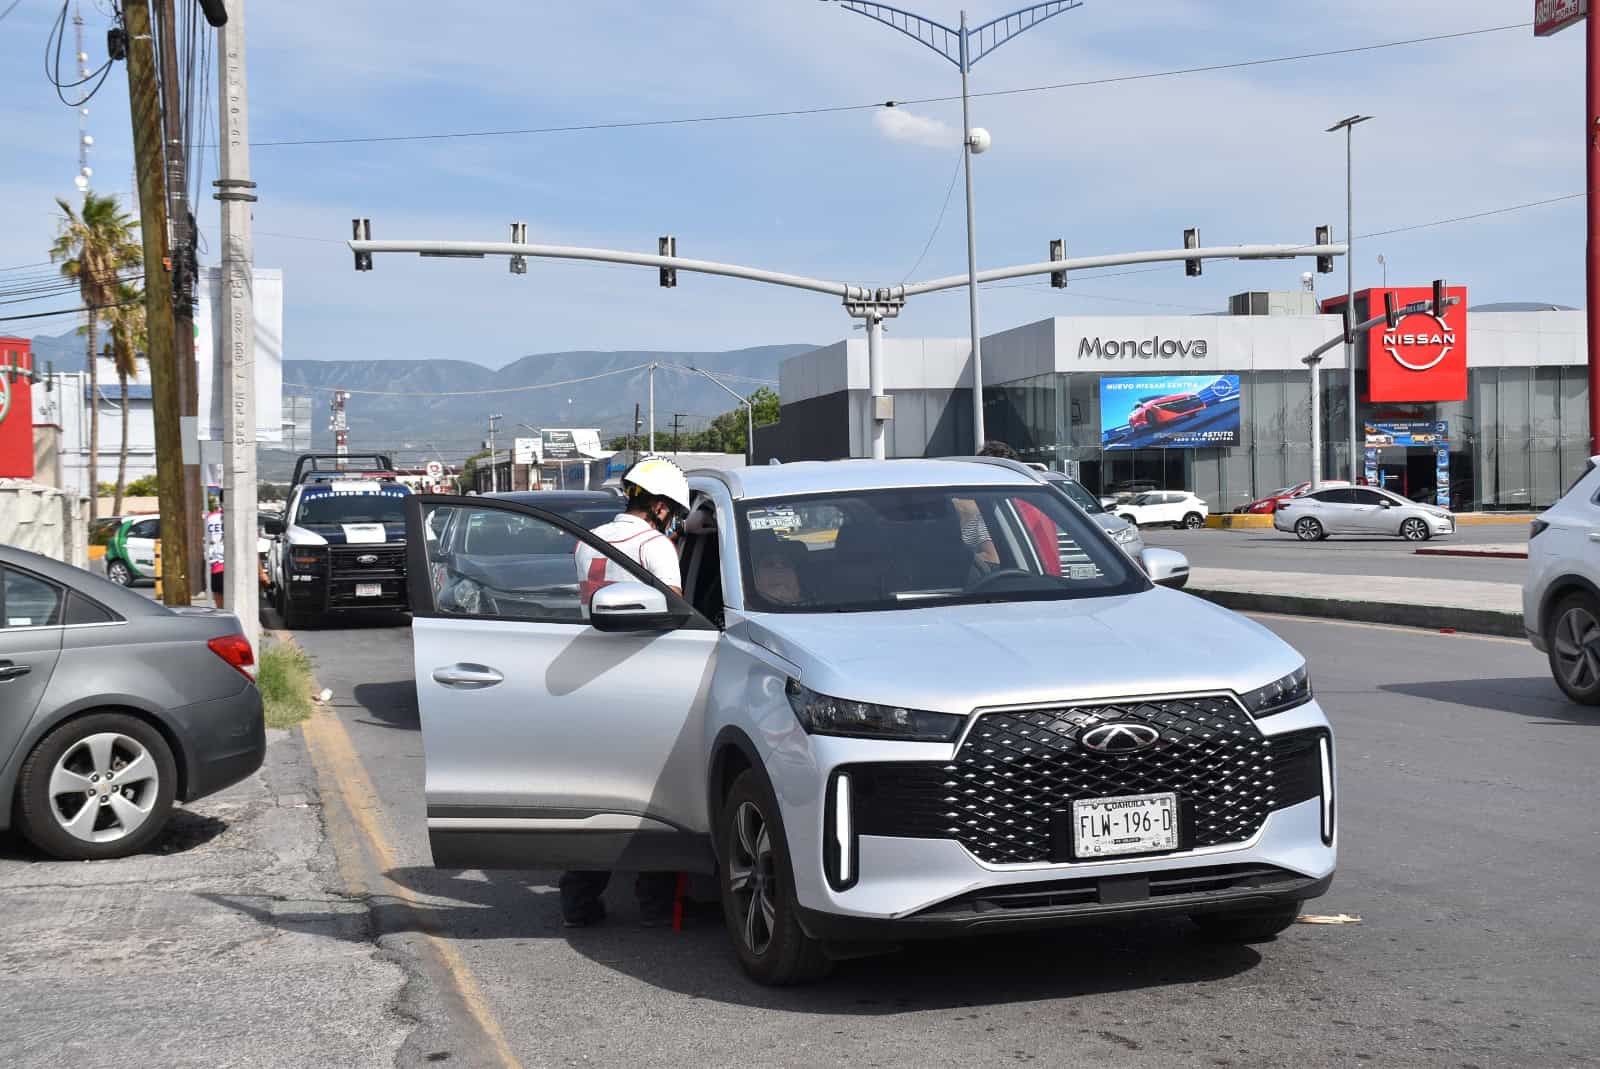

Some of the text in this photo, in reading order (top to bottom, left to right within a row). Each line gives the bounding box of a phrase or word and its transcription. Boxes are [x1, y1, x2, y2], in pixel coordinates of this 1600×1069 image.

[1078, 335, 1208, 360] Monclova
[1383, 333, 1456, 345] NISSAN
[1104, 800, 1146, 812] COAHUILA
[1080, 808, 1171, 839] FLW-196-D
